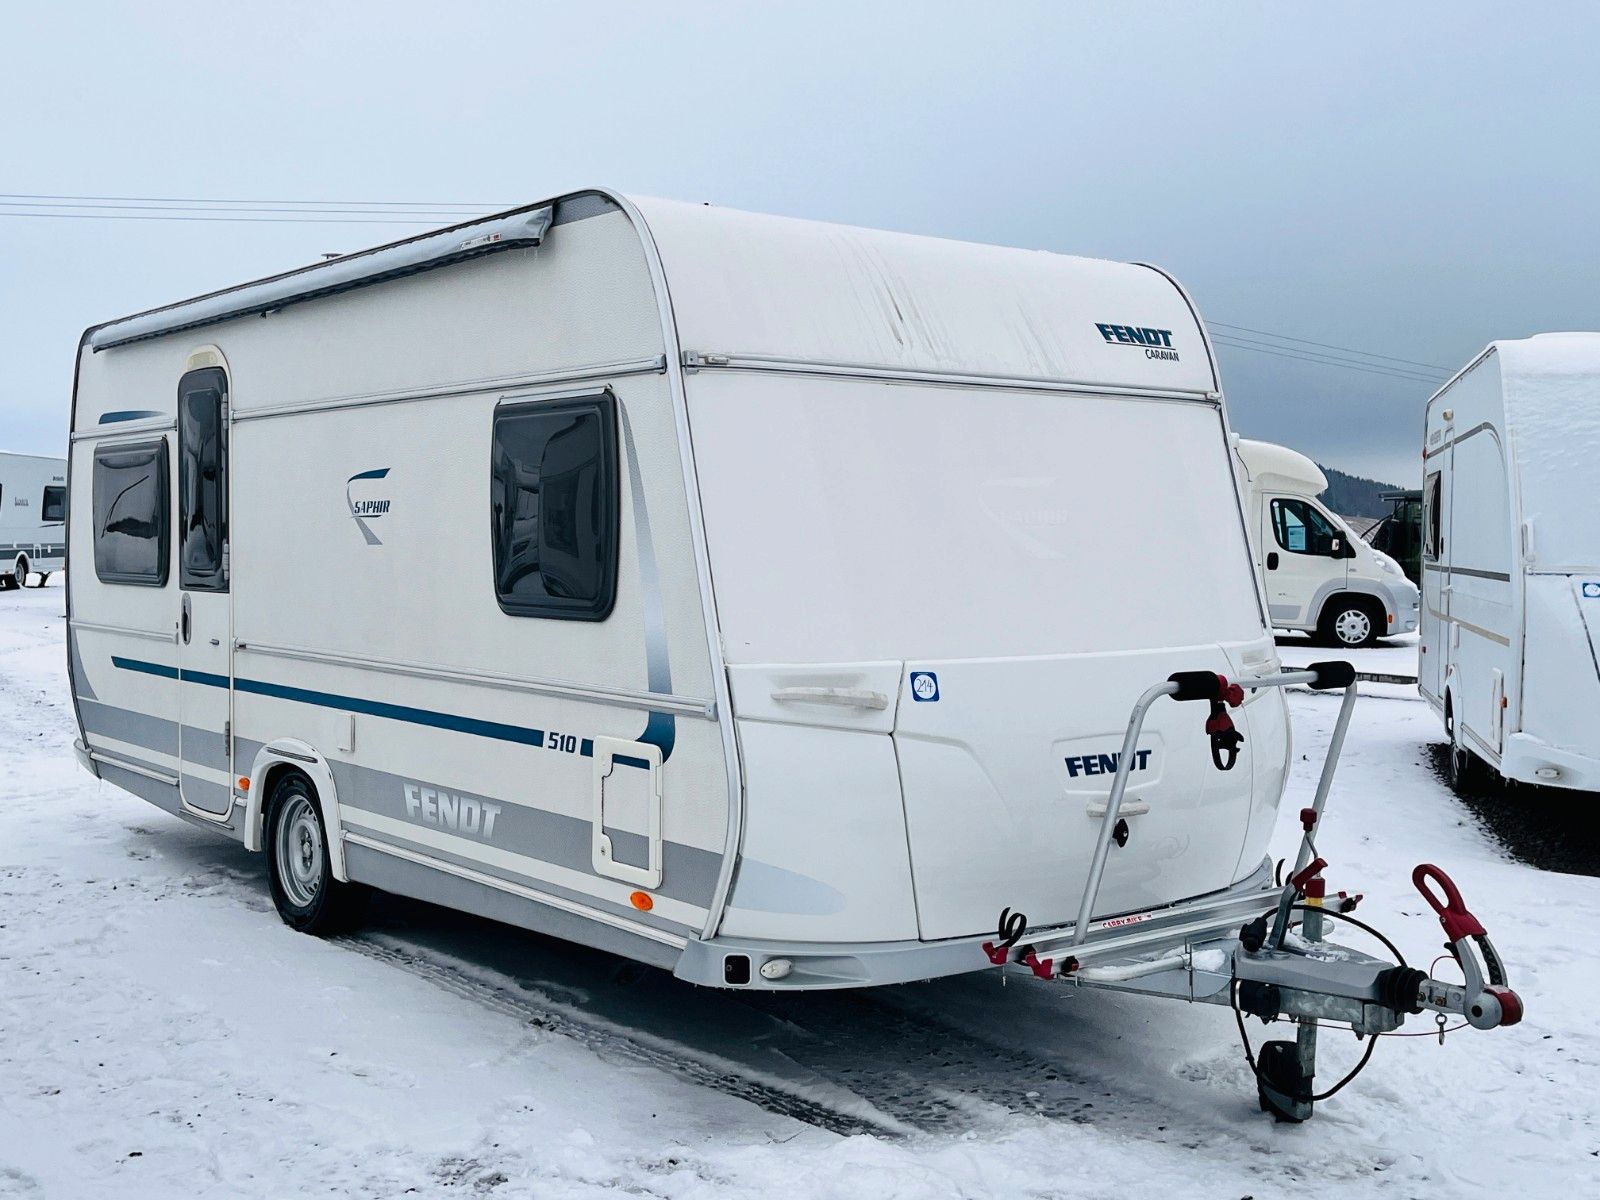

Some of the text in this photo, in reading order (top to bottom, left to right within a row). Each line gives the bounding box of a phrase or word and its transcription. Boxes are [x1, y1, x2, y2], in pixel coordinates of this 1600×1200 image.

[1095, 323, 1172, 347] FENDT
[1145, 349, 1180, 362] CARAVAN
[354, 500, 391, 514] SAPHIR
[916, 678, 934, 693] 214
[548, 732, 577, 754] 510
[403, 783, 501, 840] FENDT
